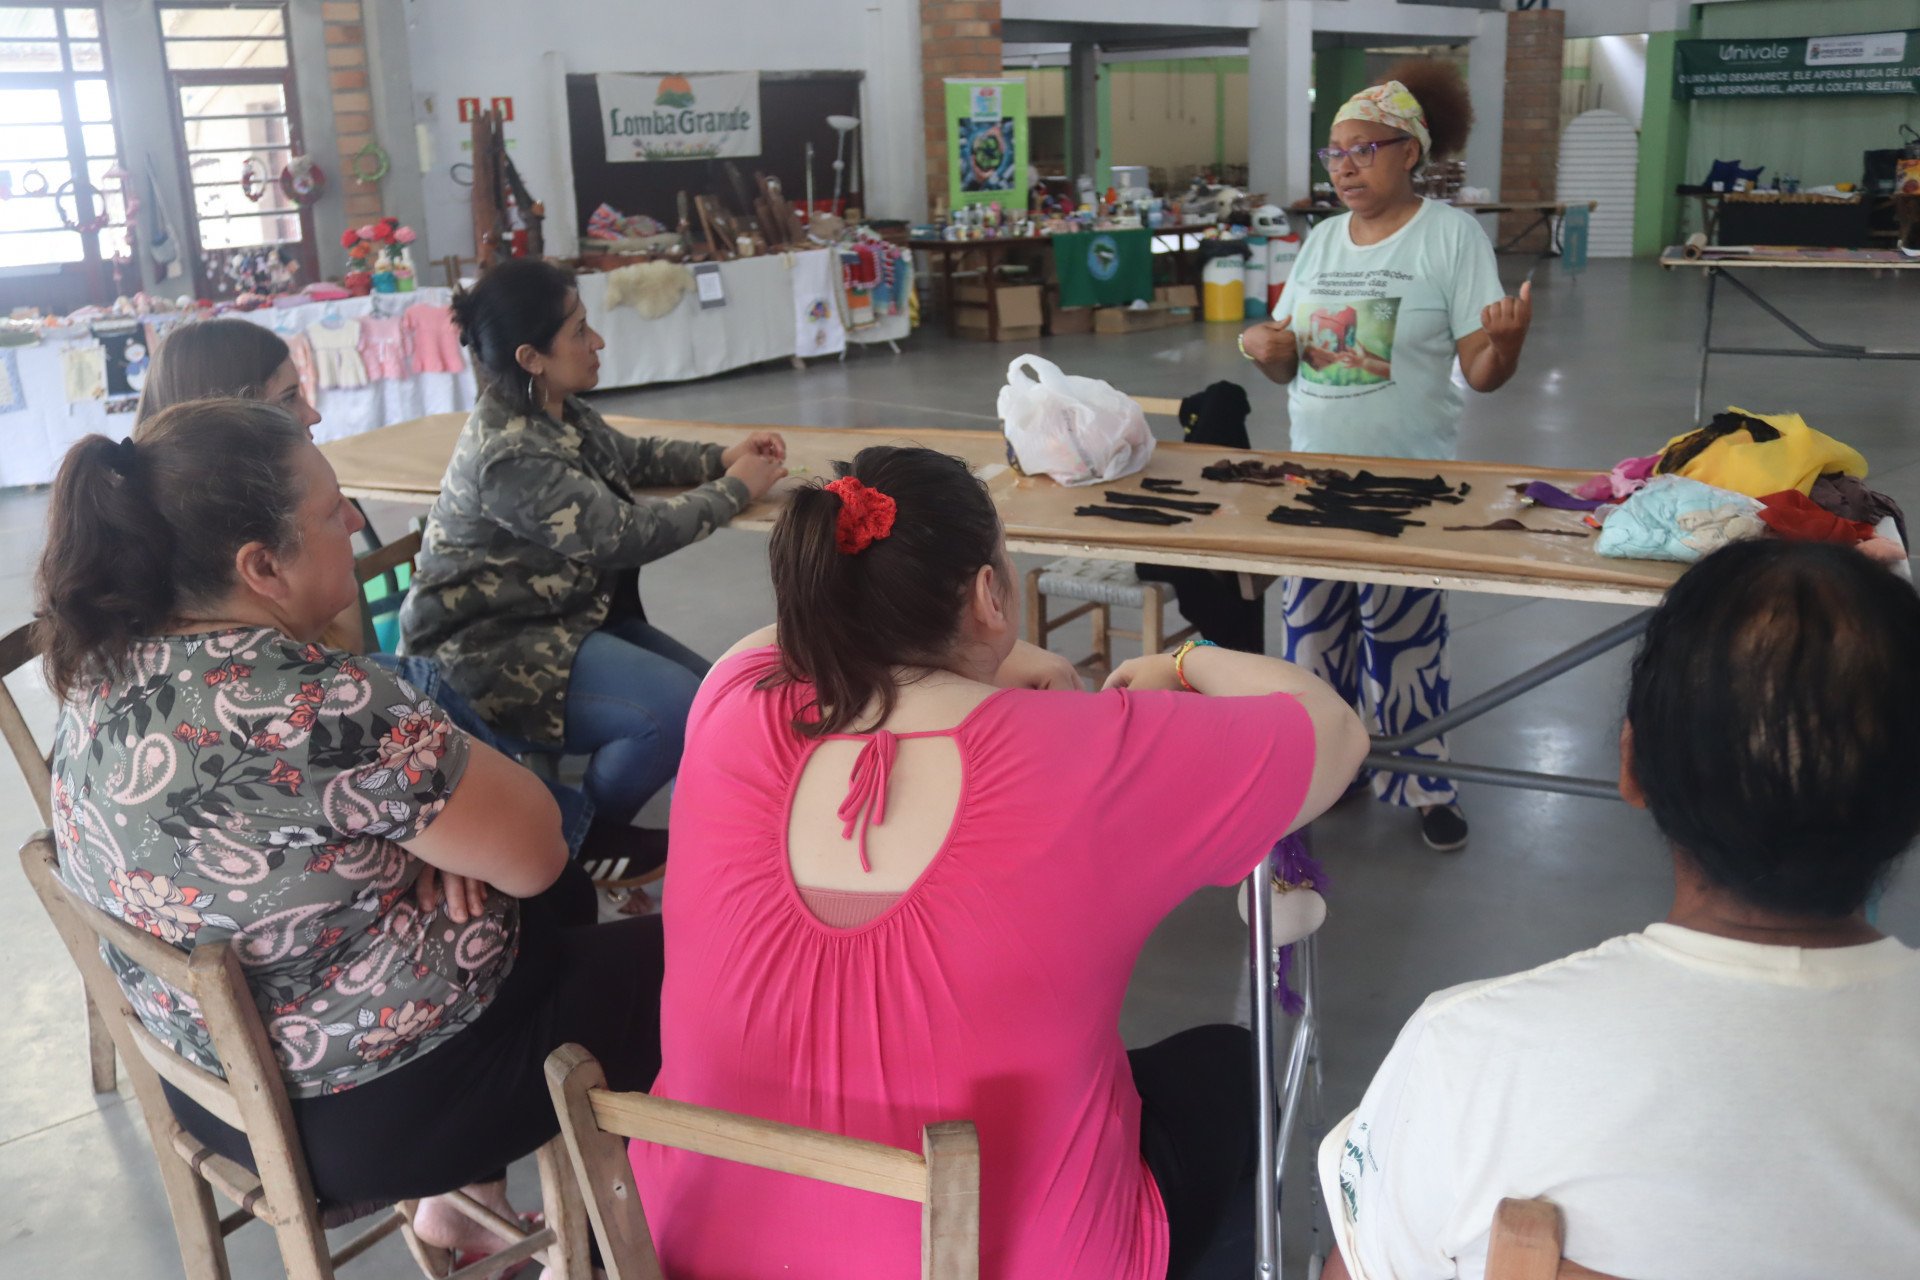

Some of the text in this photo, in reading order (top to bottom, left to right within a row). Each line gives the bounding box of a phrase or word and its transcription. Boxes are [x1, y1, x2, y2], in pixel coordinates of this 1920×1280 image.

[1719, 43, 1789, 60] Univale
[1708, 71, 1728, 82] NÃO
[1793, 70, 1811, 80] ELE
[1813, 69, 1852, 80] APENAS
[1855, 68, 1884, 78] MUDA
[1885, 67, 1900, 77] DE
[1694, 86, 1716, 95] SEJA
[1786, 83, 1815, 93] APOIE
[1816, 83, 1824, 92] A
[1825, 82, 1864, 92] COLETA
